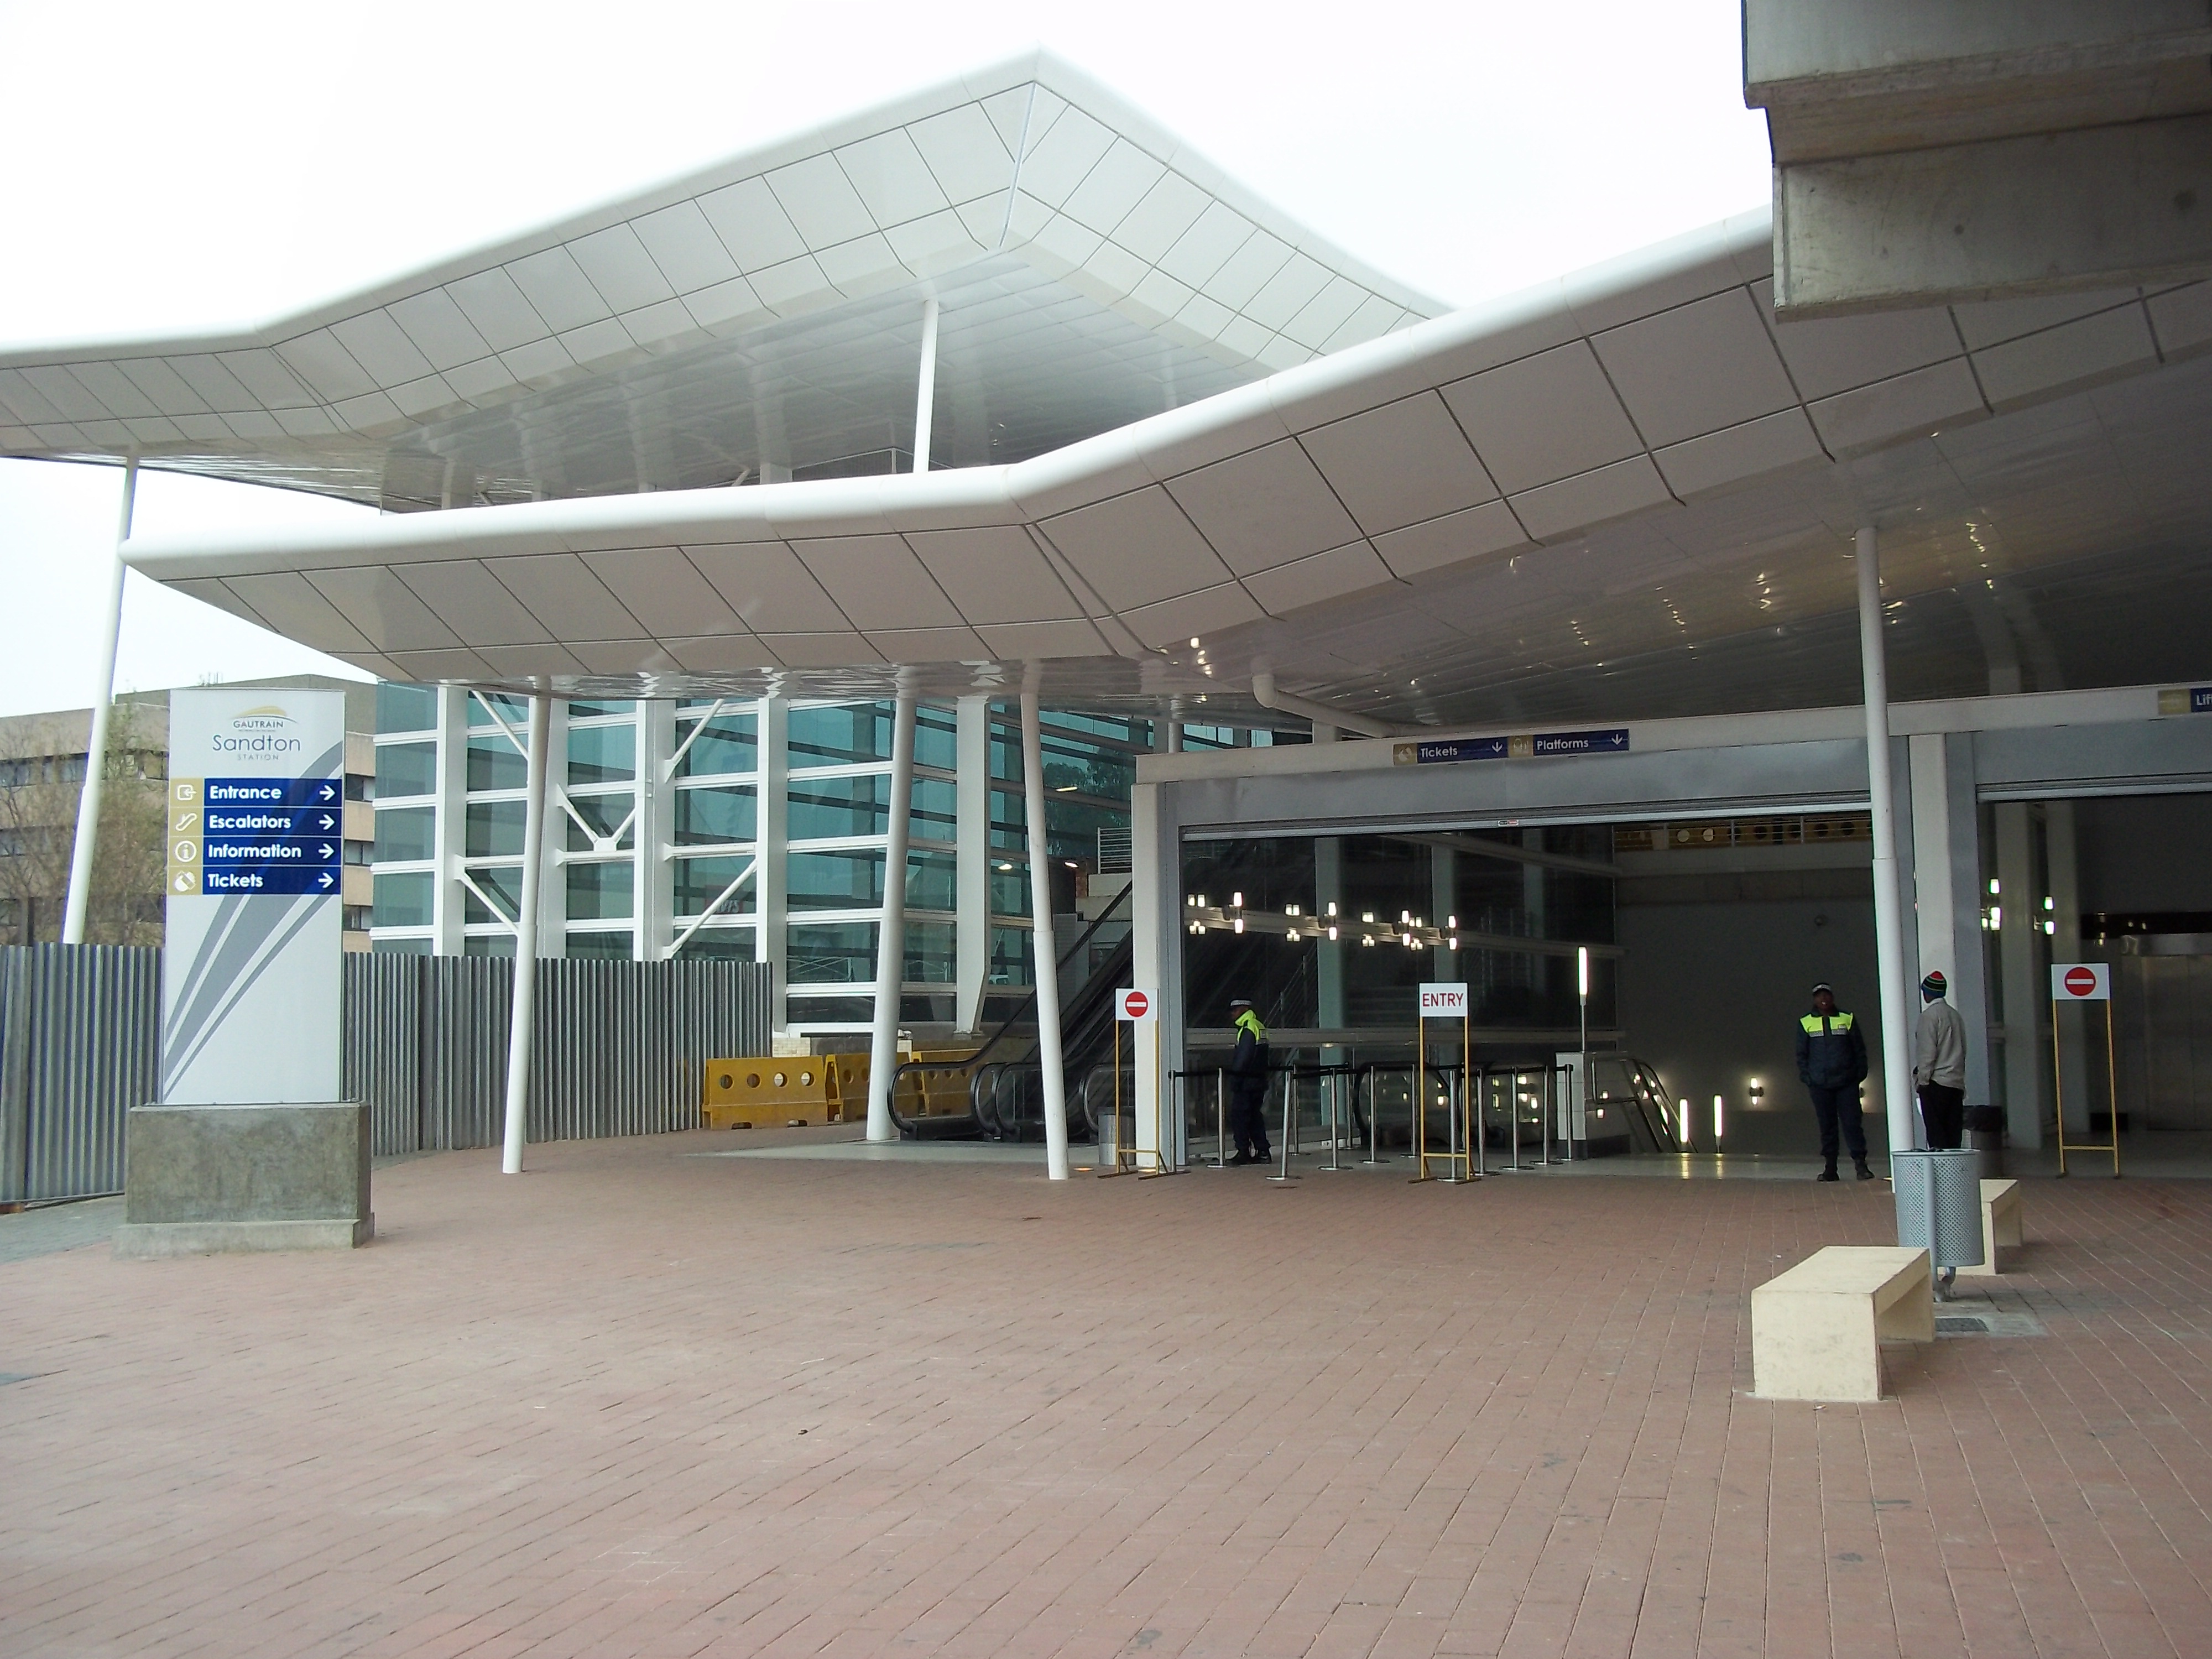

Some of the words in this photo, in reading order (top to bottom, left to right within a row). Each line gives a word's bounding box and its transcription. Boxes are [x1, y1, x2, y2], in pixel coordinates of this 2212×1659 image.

[212, 734, 300, 751] Sandton
[1537, 738, 1589, 750] Platforms
[1420, 746, 1458, 758] Tickets
[210, 785, 282, 799] Entrance
[209, 815, 291, 828] Escalators
[208, 843, 302, 858] Information
[207, 873, 264, 888] Tickets
[1422, 993, 1464, 1006] ENTRY
